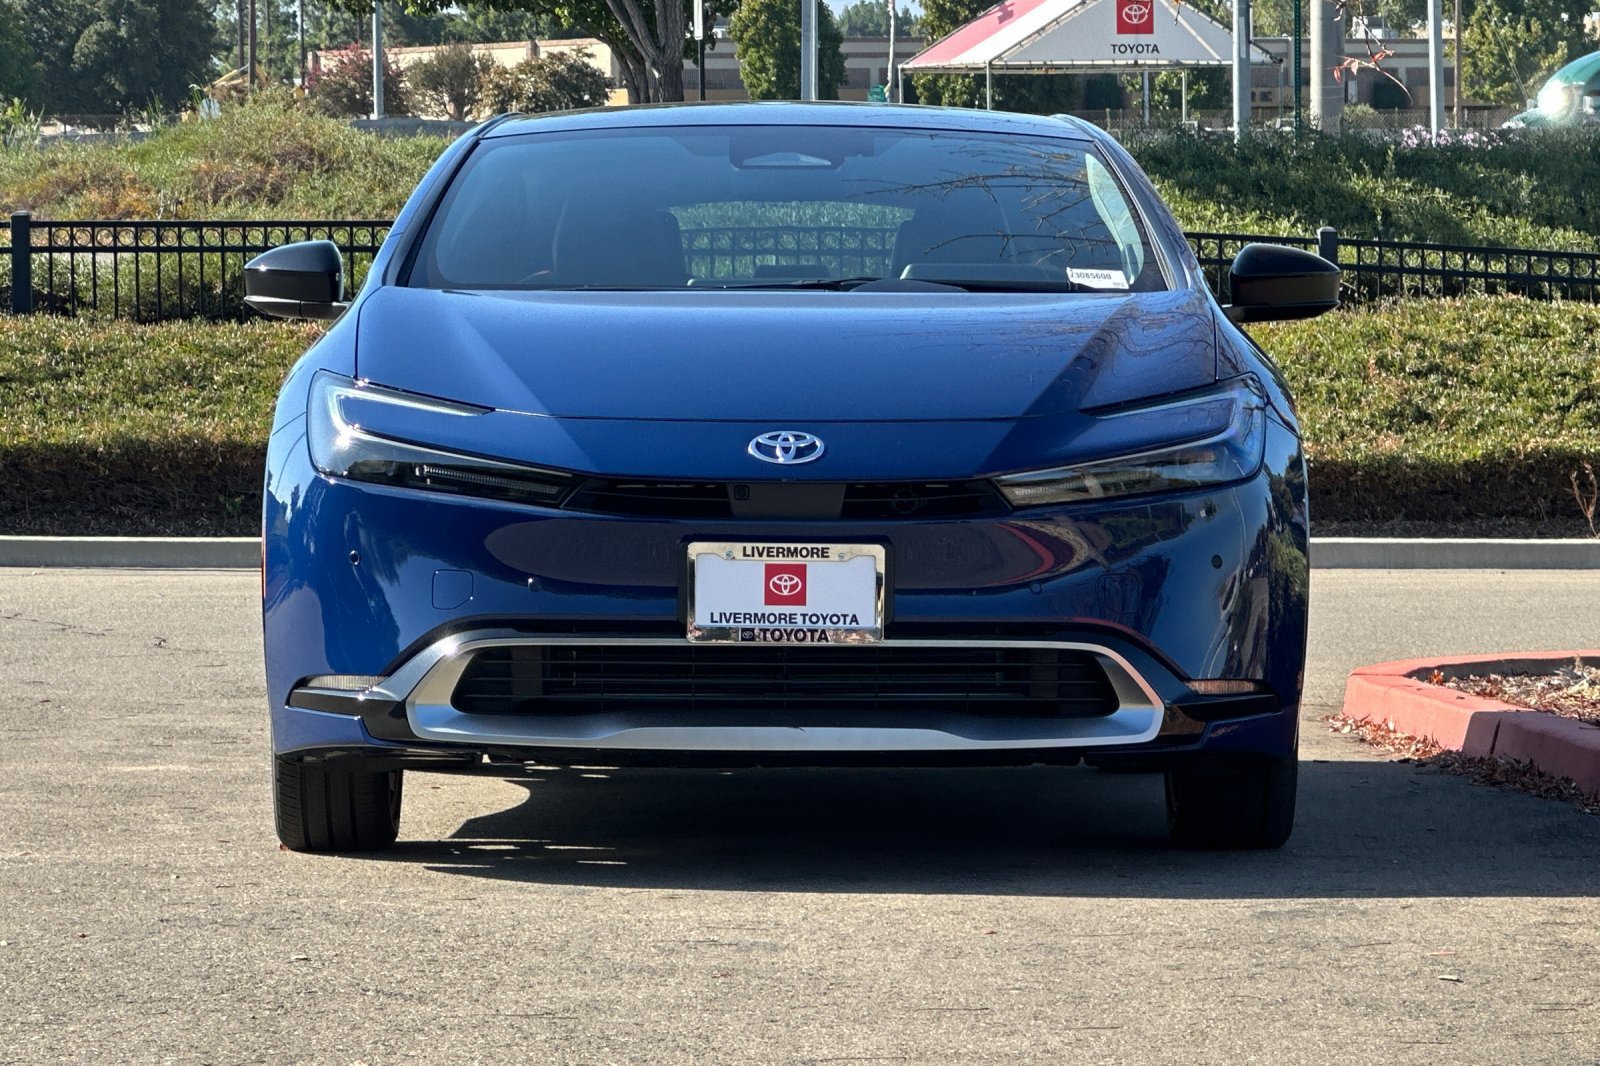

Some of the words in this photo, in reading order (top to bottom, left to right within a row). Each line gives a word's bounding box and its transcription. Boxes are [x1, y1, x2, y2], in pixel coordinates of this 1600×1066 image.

[1110, 43, 1160, 54] TOYOTA
[742, 546, 830, 558] LIVERMORE
[710, 612, 798, 625] LIVERMORE
[802, 613, 859, 625] TOYOTA
[761, 628, 829, 642] TOYOTA
